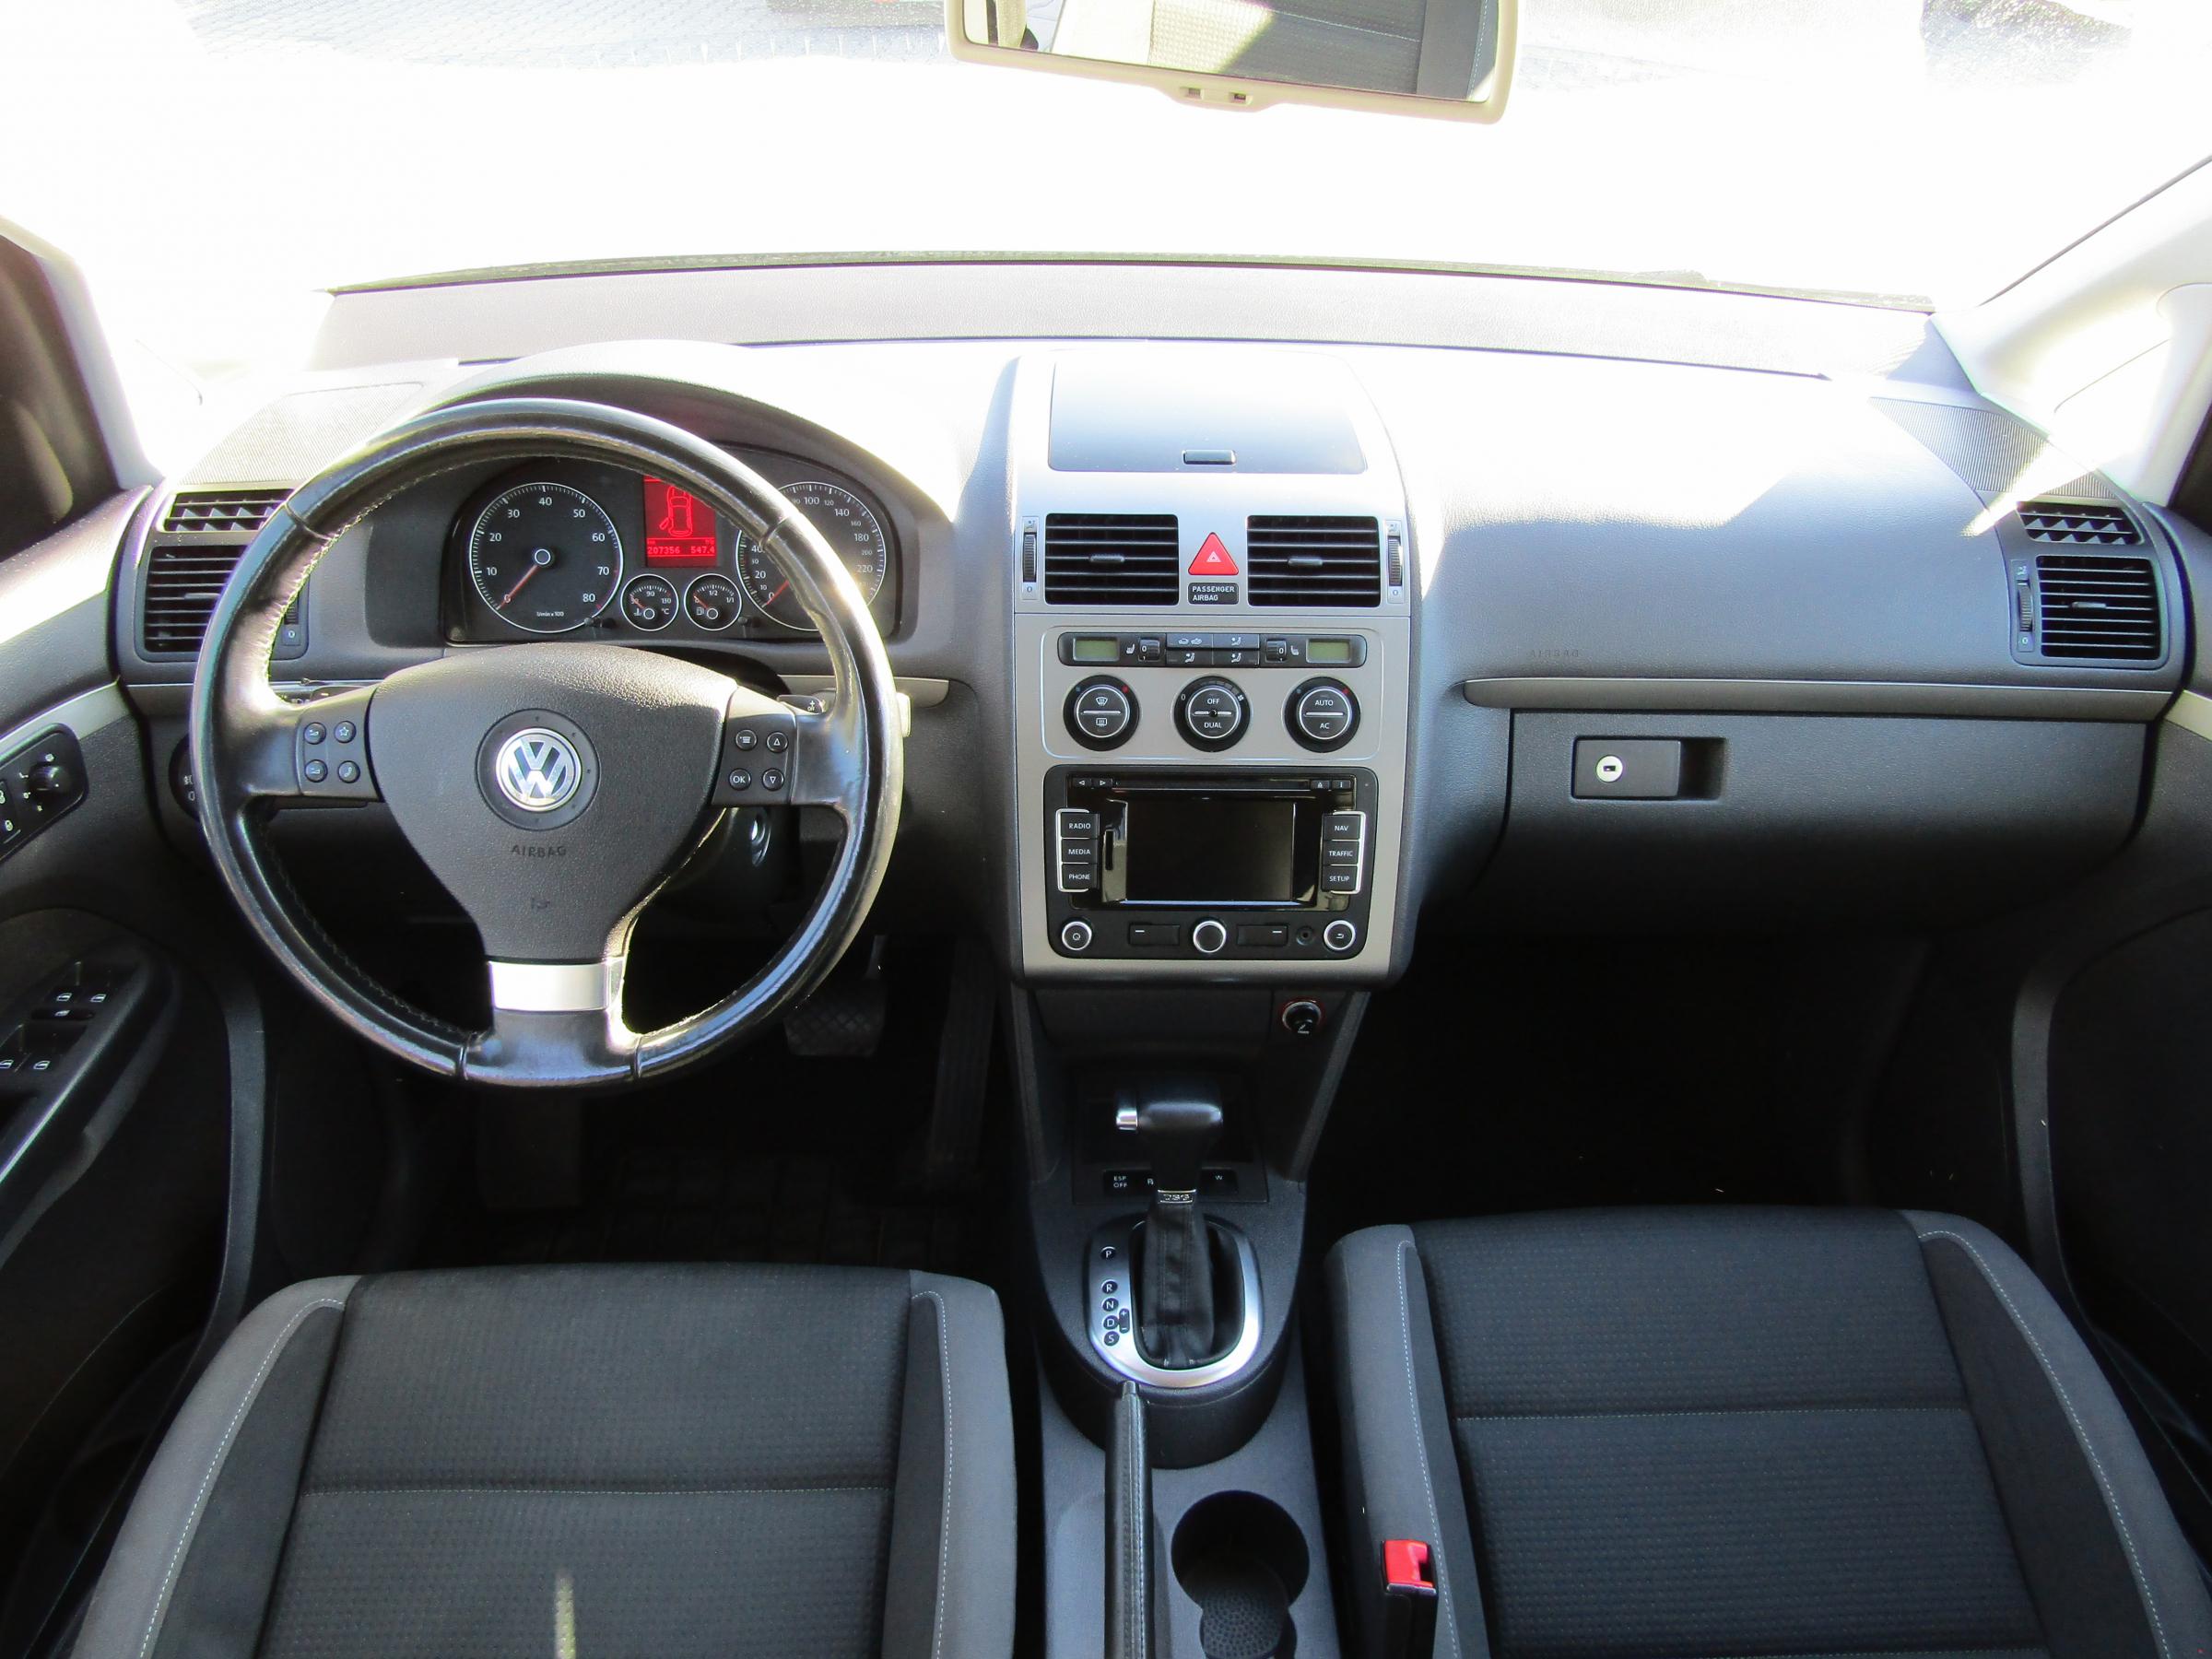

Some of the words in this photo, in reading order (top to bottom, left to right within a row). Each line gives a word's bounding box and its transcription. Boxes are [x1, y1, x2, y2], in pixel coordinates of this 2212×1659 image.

[538, 497, 552, 506] 40
[804, 496, 820, 505] 100
[507, 509, 520, 518] 30
[573, 509, 585, 518] 50
[834, 508, 850, 517] 140
[489, 533, 502, 542] 20
[592, 533, 606, 542] 60
[853, 533, 869, 542] 180
[487, 567, 498, 575] 10
[597, 566, 609, 575] 70
[856, 564, 873, 572] 220
[755, 571, 766, 579] 20
[582, 593, 595, 603] 80
[733, 775, 746, 783] OK
[511, 844, 567, 858] AIRBAG
[1105, 1250, 1112, 1258] P
[1106, 1284, 1112, 1292] R
[1106, 1300, 1114, 1309] N
[1106, 1318, 1115, 1327] D
[1108, 1334, 1114, 1343] S
